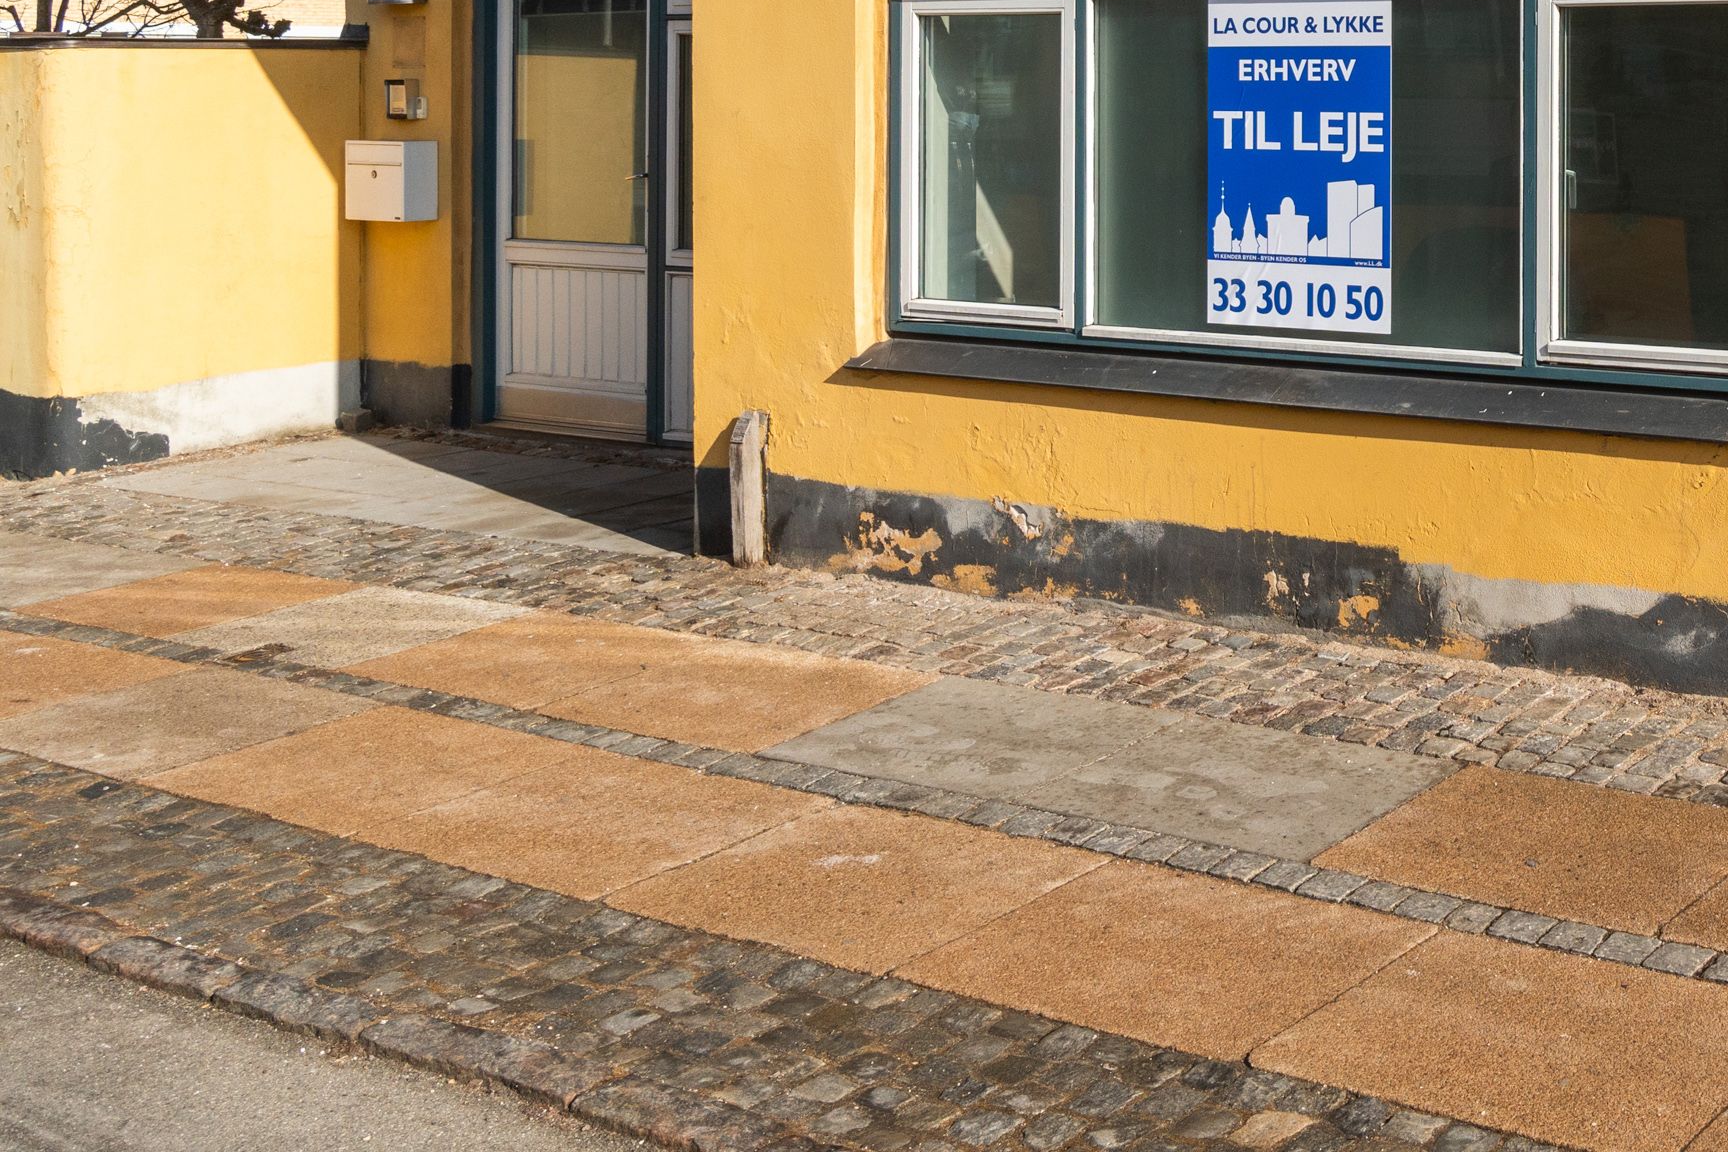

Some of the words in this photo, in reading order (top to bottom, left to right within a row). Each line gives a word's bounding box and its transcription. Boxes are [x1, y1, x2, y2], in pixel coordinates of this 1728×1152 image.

[1213, 17, 1238, 35] LA
[1242, 15, 1299, 34] COUR
[1304, 16, 1318, 34] &
[1323, 15, 1384, 33] LYKKE
[1238, 58, 1356, 82] ERHVERV
[1212, 110, 1281, 151] TIL
[1293, 111, 1385, 163] LEJE
[1212, 277, 1247, 313] 33
[1256, 279, 1293, 316] 30
[1306, 282, 1336, 319] 10
[1344, 284, 1384, 322] 50
